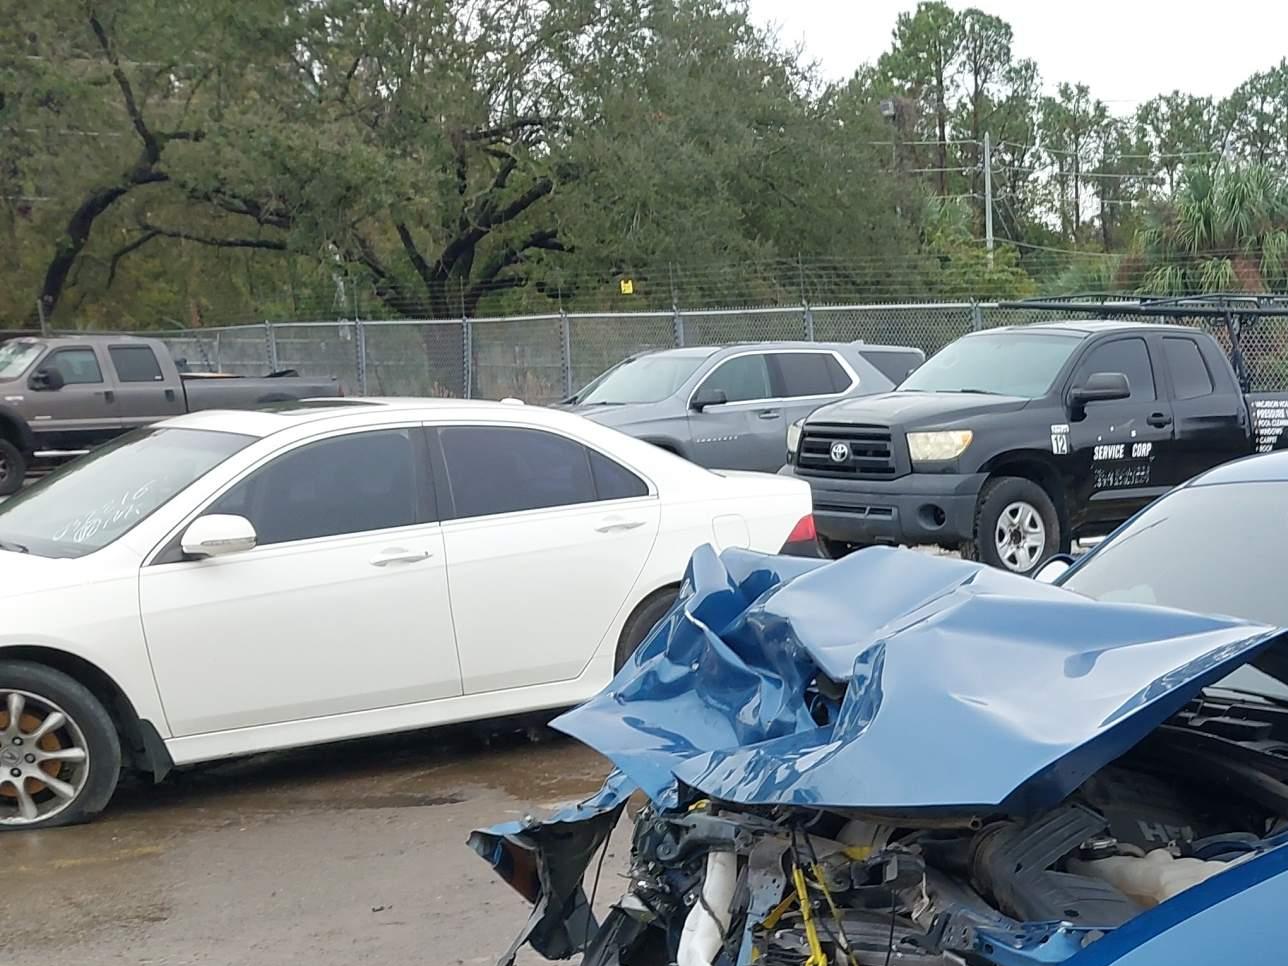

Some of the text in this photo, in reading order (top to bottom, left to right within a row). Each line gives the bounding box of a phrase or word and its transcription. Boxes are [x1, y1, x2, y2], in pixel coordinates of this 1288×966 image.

[1256, 408, 1285, 418] PRESSURE
[1053, 435, 1066, 453] 12
[1259, 436, 1278, 444] CARPET
[1093, 442, 1152, 461] SERVICE CORP
